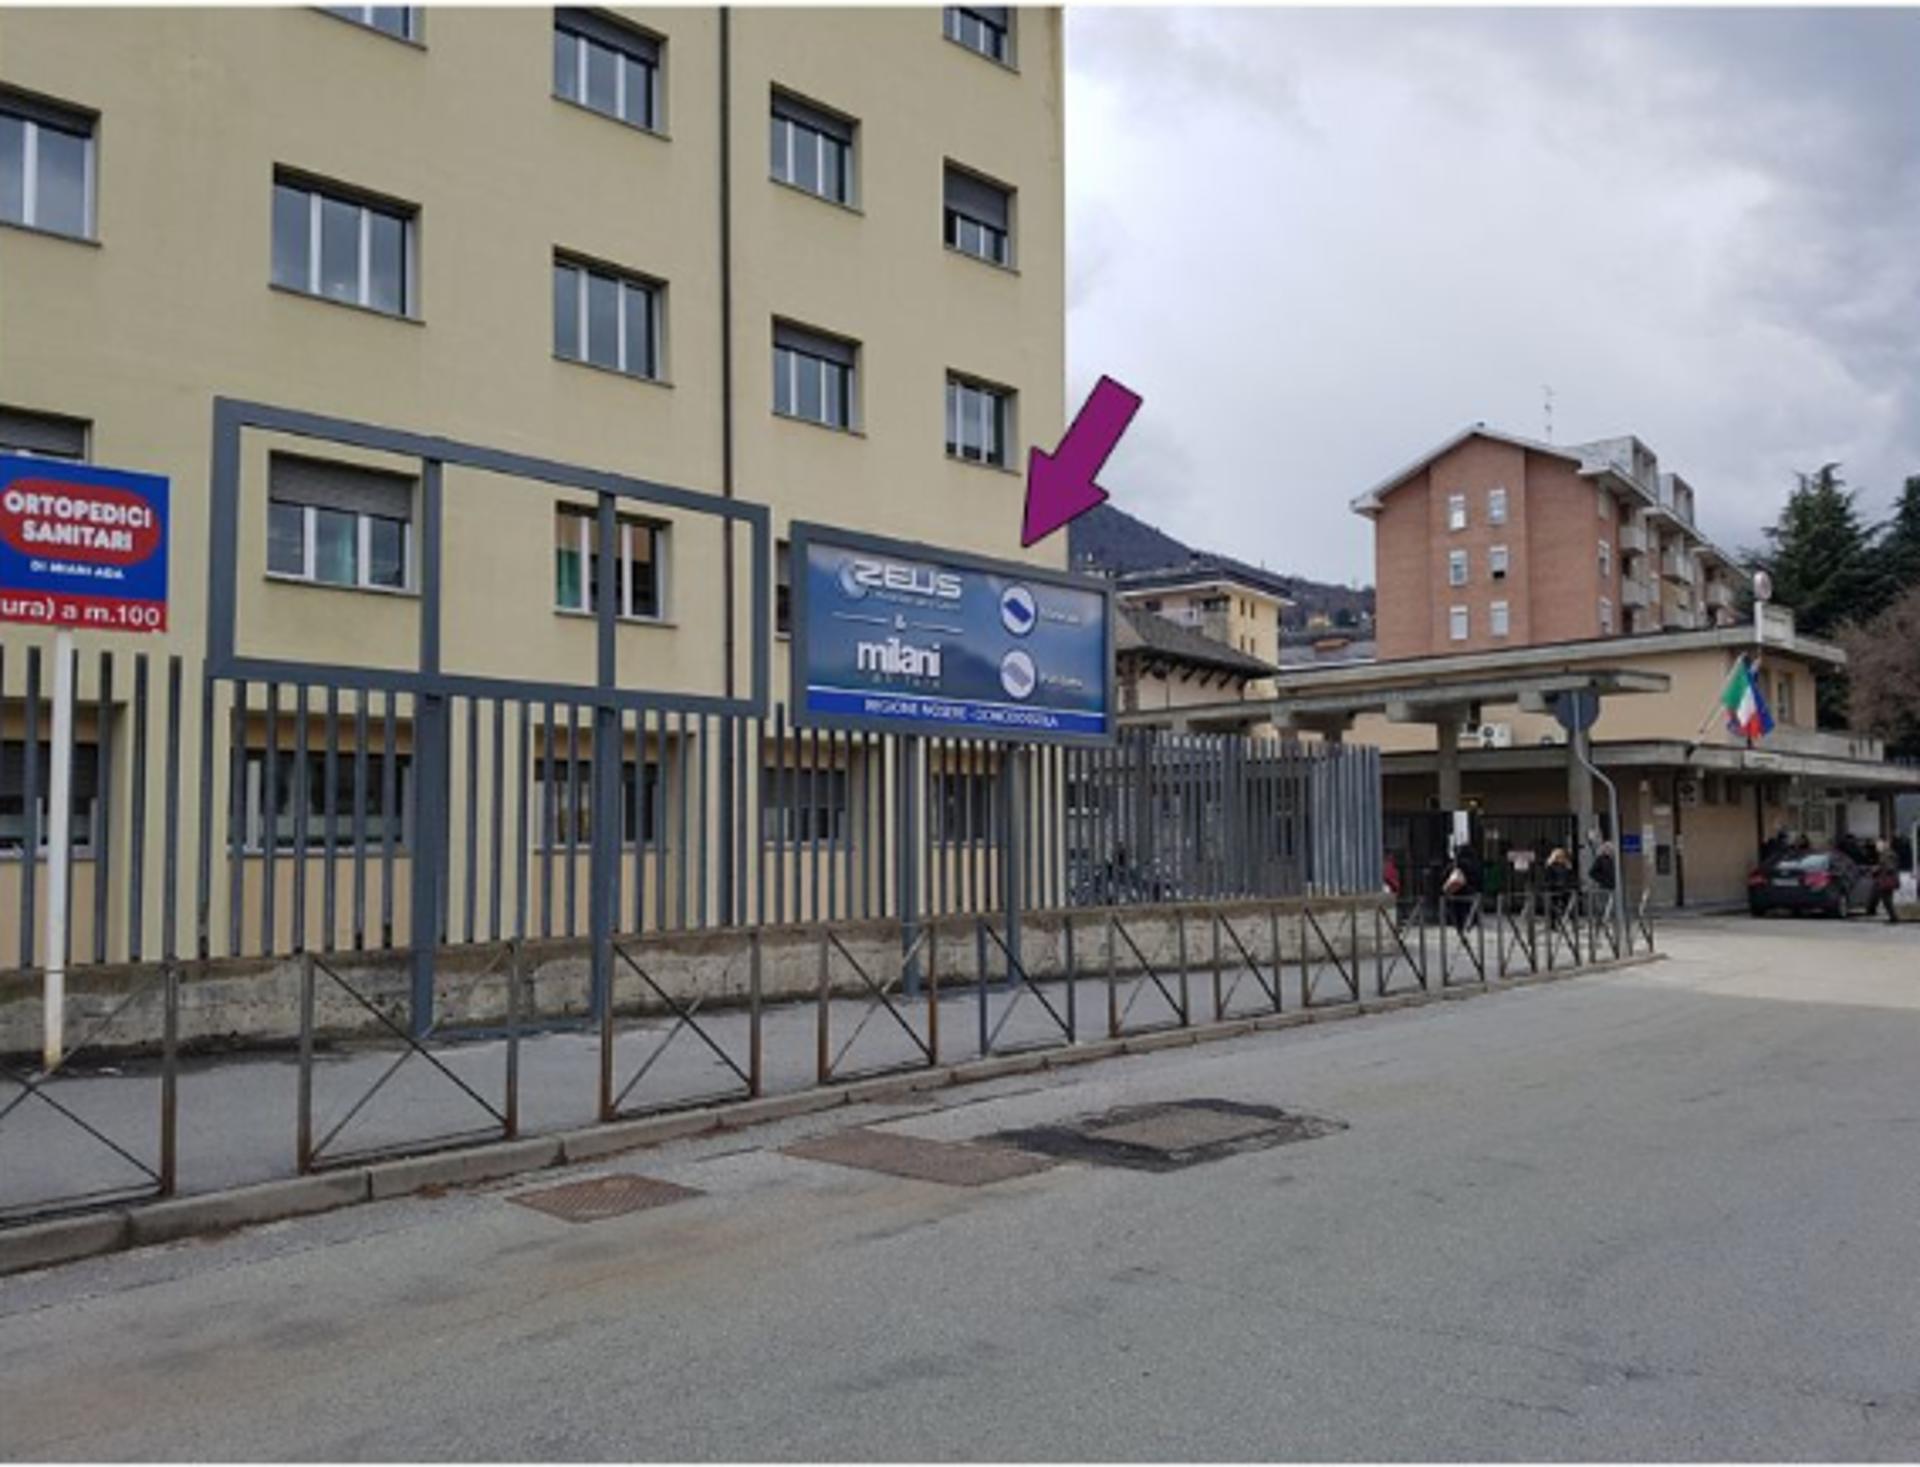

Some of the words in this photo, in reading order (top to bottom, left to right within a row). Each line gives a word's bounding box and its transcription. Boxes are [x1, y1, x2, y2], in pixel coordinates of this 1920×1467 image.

[4, 490, 152, 528] ORTOPEDICI
[22, 520, 133, 551] SANITARI
[854, 560, 962, 599] ZEUS
[61, 605, 78, 620] a
[857, 637, 941, 677] milani
